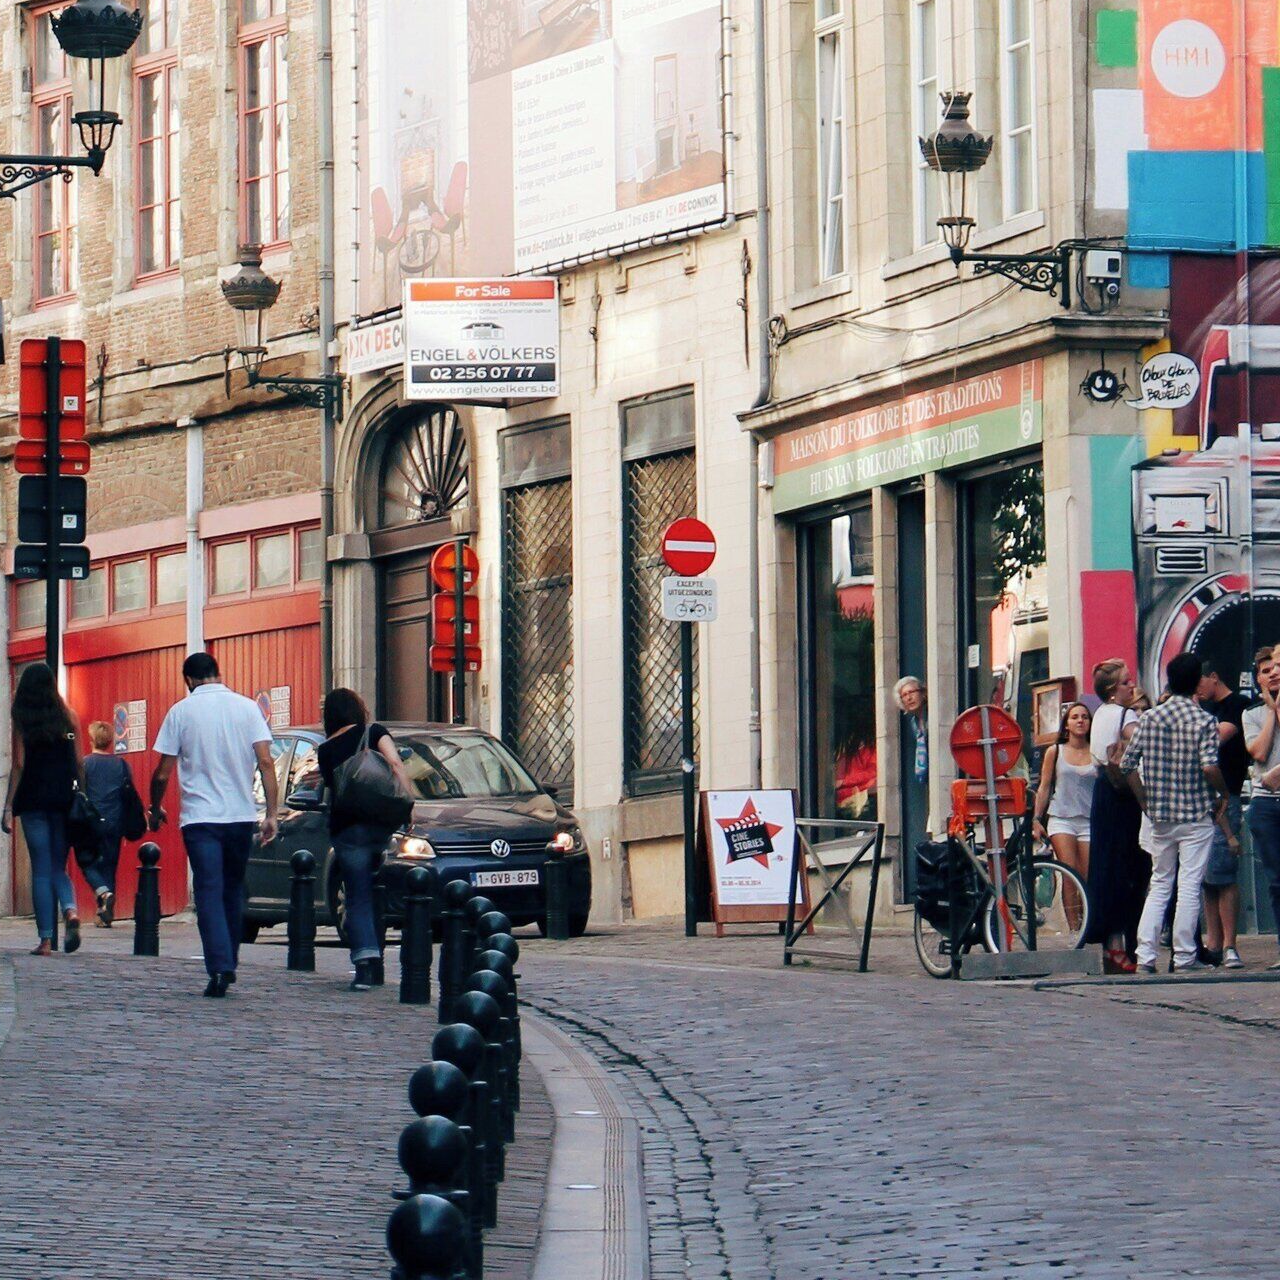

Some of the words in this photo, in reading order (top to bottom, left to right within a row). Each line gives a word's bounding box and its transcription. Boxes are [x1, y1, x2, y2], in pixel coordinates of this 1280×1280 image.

[1165, 47, 1209, 67] HMI
[455, 285, 480, 297] For
[481, 285, 511, 297] Sale
[430, 367, 452, 380] 02
[454, 367, 487, 379] 256
[490, 367, 511, 378] 07
[515, 366, 536, 379] 77
[411, 384, 556, 396] www.engelvoelkers.be
[1161, 379, 1175, 388] DE
[790, 428, 829, 462] MAISON
[830, 422, 846, 449] DU
[847, 406, 900, 443] FOLKLORE
[901, 400, 914, 426] ET
[916, 394, 936, 423] DES
[937, 376, 1002, 416] TRADITIONS
[810, 467, 833, 496] HUIS
[834, 461, 854, 487] VAN
[856, 444, 909, 481] FOLKLORE
[911, 440, 925, 465] EN
[922, 424, 980, 461] TRADITIES
[733, 838, 765, 852] STORIES
[478, 872, 537, 885] 1-GVB-879
